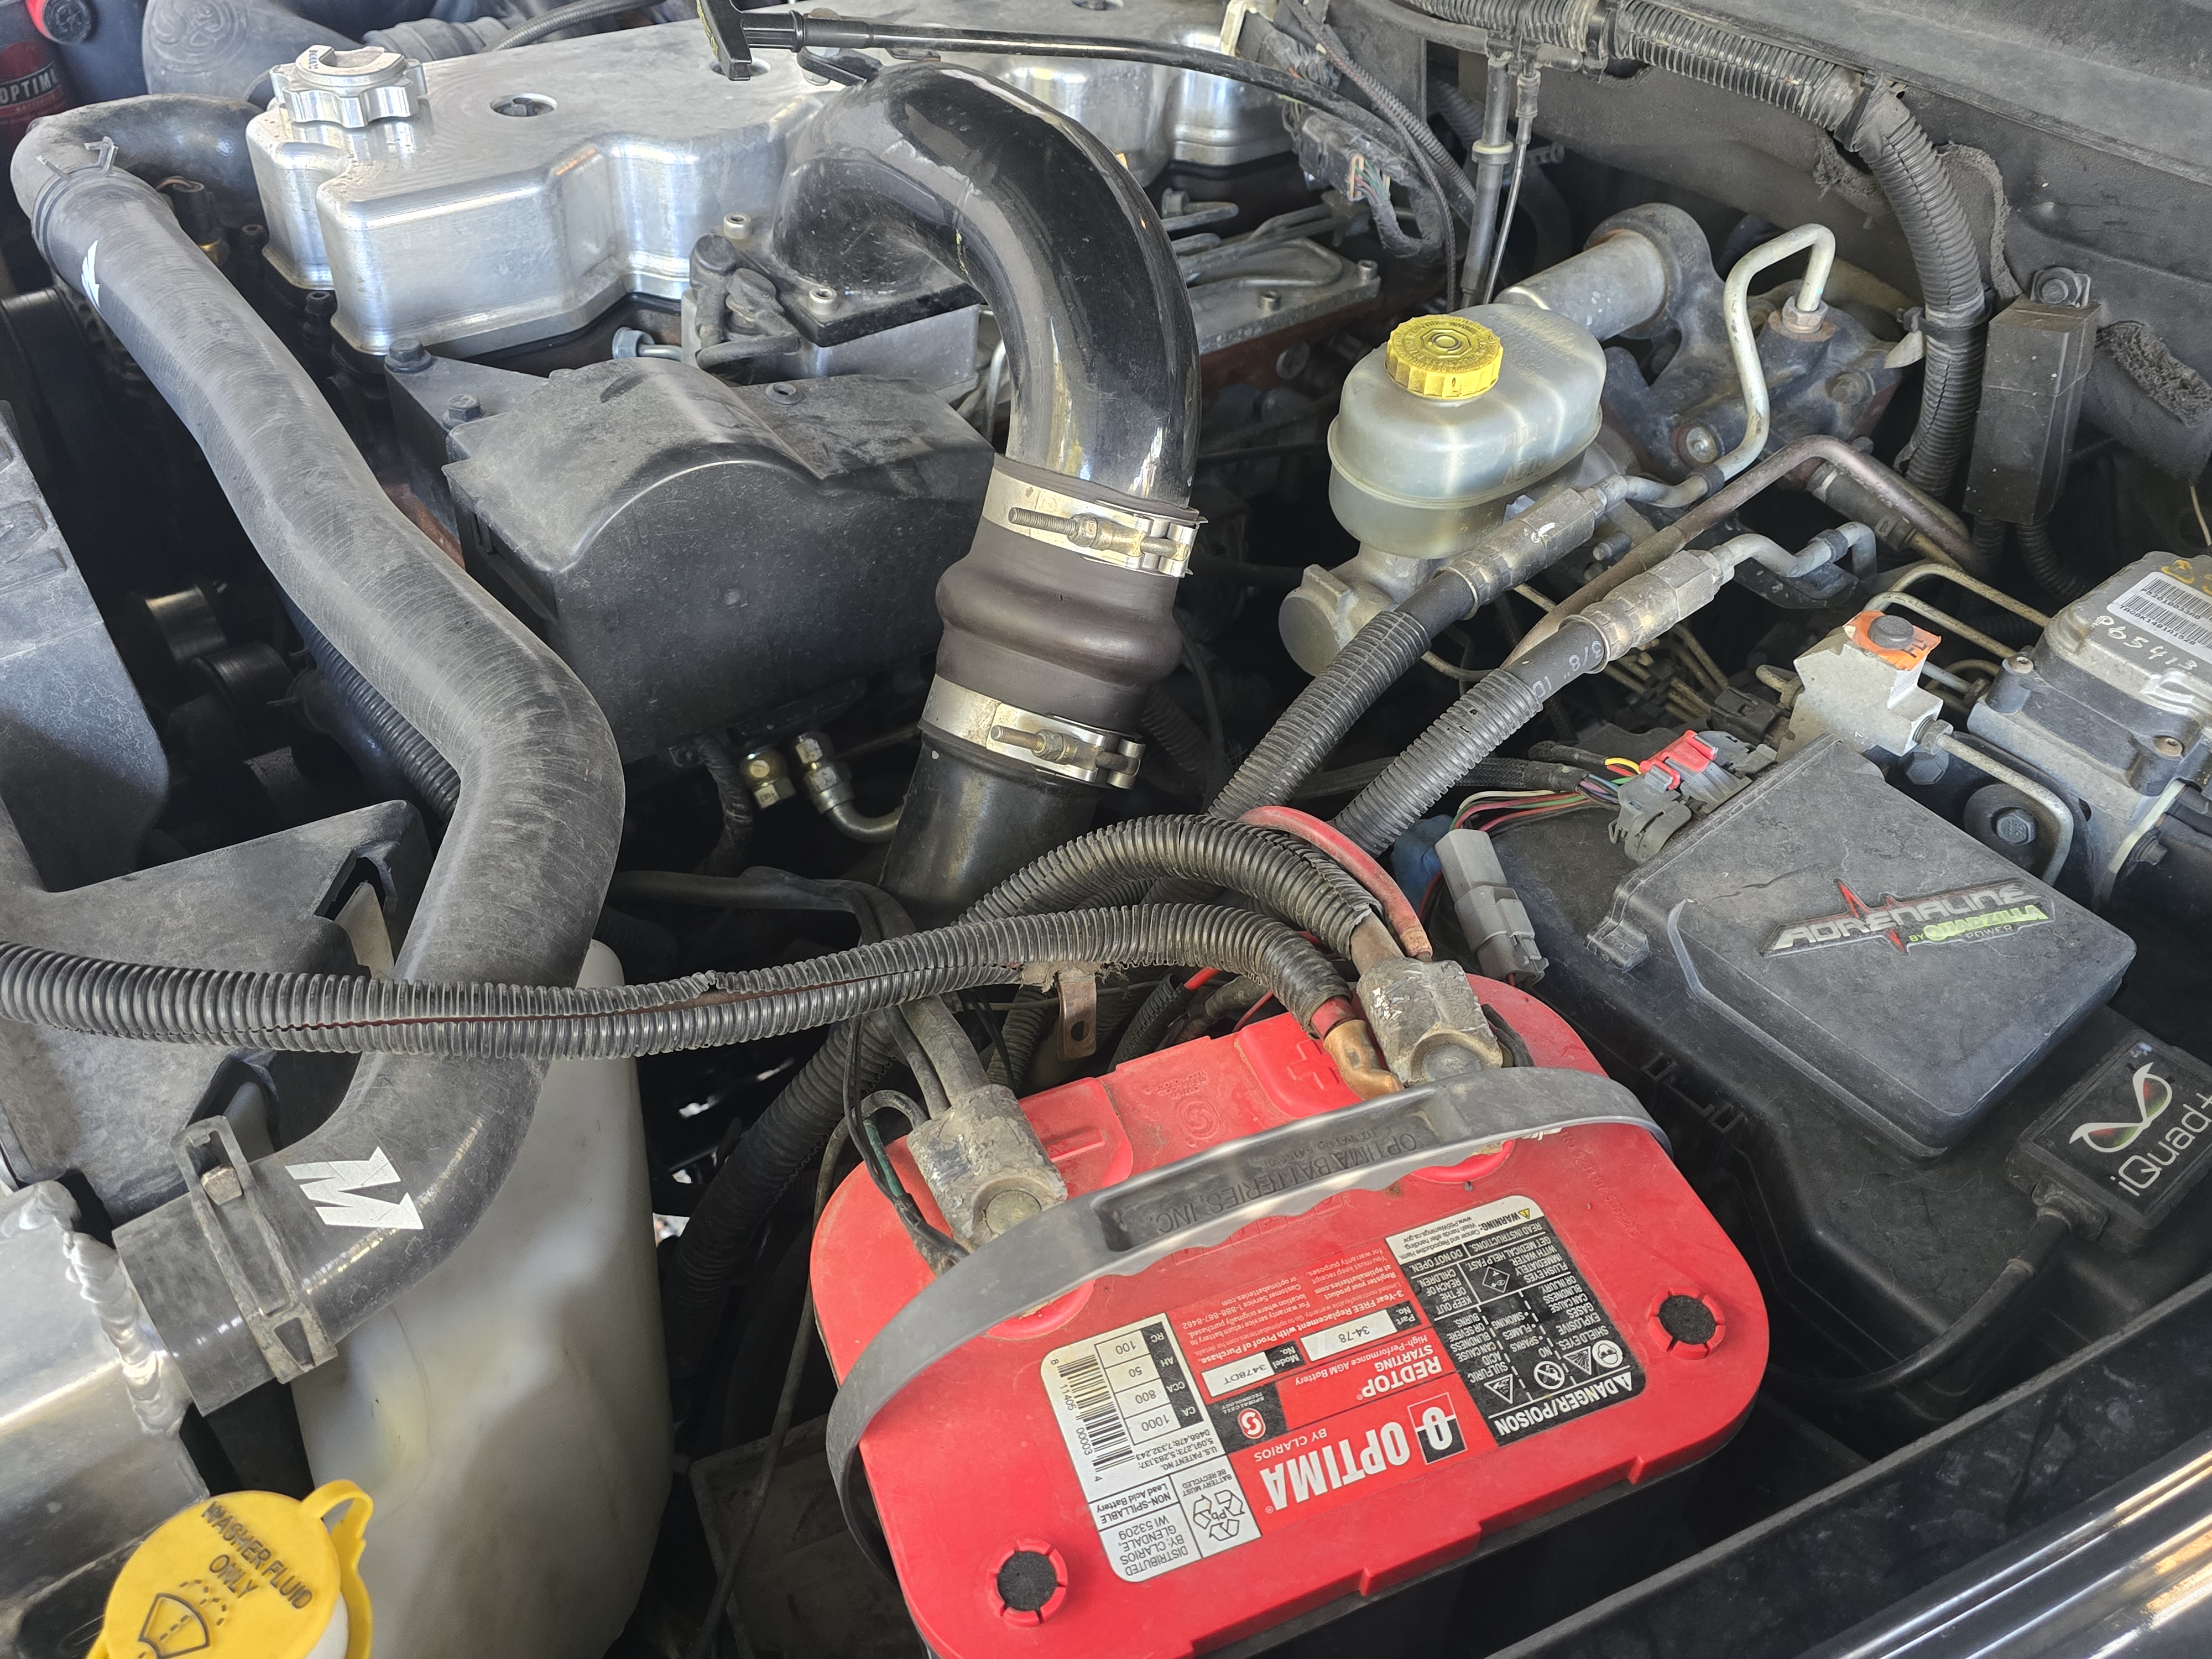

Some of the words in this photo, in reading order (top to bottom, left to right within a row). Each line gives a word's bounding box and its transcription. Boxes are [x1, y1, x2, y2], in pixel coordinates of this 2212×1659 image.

[2091, 615, 2198, 671] P65413
[1532, 676, 1552, 698] ID
[1773, 885, 2042, 950] ADRENALINE
[1909, 933, 1924, 943] BY
[1923, 904, 2048, 941] QUADZILLA
[1966, 925, 2013, 939] POWER
[1332, 1133, 1417, 1170] OPTIMA
[2110, 1091, 2212, 1196] iQuad+
[1150, 1202, 1196, 1233] INC.
[1477, 1212, 1520, 1232] WARNING:
[1441, 1227, 1460, 1238] hands
[1458, 1221, 1477, 1232] Wash
[1459, 1228, 1480, 1239] Cancer
[1520, 1222, 1542, 1235] READ
[1403, 1237, 1430, 1251] handling.
[1428, 1233, 1443, 1243] after
[1448, 1235, 1460, 1243] and
[1469, 1228, 1524, 1253] INSTRUCTIONS.
[1534, 1235, 1552, 1247] GET
[1369, 1246, 1383, 1257] for
[1415, 1239, 1450, 1255] Reproductive
[1449, 1249, 1463, 1259] DO
[1503, 1240, 1537, 1258] MEDICAL
[1535, 1244, 1557, 1257] WITH
[1339, 1250, 1372, 1267] warranty
[1371, 1254, 1387, 1264] You
[1397, 1250, 1416, 1261] Harm.
[1432, 1253, 1451, 1265] NOT
[1484, 1251, 1506, 1265] HELP
[1508, 1250, 1538, 1267] WATER.
[1305, 1260, 1341, 1279] purposes.
[1335, 1265, 1354, 1276] keep
[1353, 1259, 1373, 1271] must
[1382, 1263, 1392, 1272] at
[1408, 1258, 1434, 1274] OPEN.
[1464, 1258, 1488, 1271] FAST.
[1513, 1253, 1563, 1275] IMMEDIATELY
[1541, 1261, 1568, 1276] FLUSH
[1288, 1275, 1298, 1284] or
[1310, 1271, 1337, 1285] receipt
[1313, 1266, 1384, 1295] optimabatteries.com
[1365, 1270, 1396, 1286] Register
[1416, 1268, 1457, 1288] CHILDREN.
[1434, 1277, 1462, 1292] REACH
[1522, 1270, 1544, 1283] EYES
[1563, 1274, 1577, 1285] OR
[1220, 1277, 1290, 1307] optimabatteries.com
[1267, 1283, 1302, 1300] Customer
[1323, 1285, 1352, 1301] product
[1350, 1280, 1368, 1292] your
[1424, 1286, 1436, 1296] OF
[1454, 1286, 1467, 1296] OF
[1537, 1278, 1567, 1294] INJURY.
[1542, 1284, 1583, 1304] BLINDNESS
[1242, 1294, 1269, 1308] Service
[1277, 1292, 1307, 1308] location
[1374, 1288, 1405, 1305] 3-Year
[1439, 1289, 1457, 1302] THE
[1450, 1295, 1472, 1308] KEEP
[1569, 1292, 1588, 1305] CAN
[1255, 1301, 1279, 1315] where
[1267, 1303, 1298, 1320] warranty
[1296, 1299, 1311, 1310] For
[1351, 1298, 1376, 1313] FREE
[1395, 1305, 1411, 1317] No.
[1434, 1301, 1453, 1314] OUT
[1547, 1297, 1573, 1313] CAUSE
[1565, 1301, 1595, 1319] GASES
[1181, 1303, 1243, 1329] 1-888-867-8462
[1224, 1309, 1258, 1326] originally
[1242, 1313, 1270, 1329] service
[1296, 1306, 1353, 1332] Replacement
[1395, 1313, 1416, 1326] Part
[1452, 1312, 1480, 1328] BURNS.
[1490, 1311, 1525, 1329] SMOKING
[1554, 1311, 1601, 1335] EXPLOSIVE
[1186, 1319, 1226, 1339] purchased.
[1222, 1322, 1245, 1336] return
[1275, 1325, 1297, 1339] with
[1337, 1324, 1371, 1343] 34-78
[1446, 1326, 1475, 1342] SEVERE
[1472, 1322, 1486, 1333] OR
[1501, 1323, 1532, 1340] FLAMES
[1577, 1324, 1609, 1343] SHIELD
[1149, 1332, 1165, 1343] RC
[1189, 1337, 1199, 1347] to
[1197, 1329, 1224, 1344] battery
[1251, 1332, 1277, 1348] Proof
[1449, 1331, 1491, 1353] BLINDNESS
[1509, 1335, 1539, 1352] SPARKS
[1555, 1334, 1582, 1351] EYES.
[1114, 1340, 1137, 1355] 100
[1240, 1340, 1253, 1352] of
[1279, 1345, 1296, 1357] No.
[1349, 1332, 1429, 1368] High-Performance
[1455, 1346, 1481, 1362] CAUSE
[1479, 1340, 1497, 1353] CAN
[1536, 1345, 1553, 1358] NO
[1160, 1355, 1175, 1367] AH
[1197, 1344, 1243, 1366] Purchase.
[1271, 1353, 1300, 1369] Model
[1373, 1343, 1435, 1373] STARTING
[1480, 1350, 1503, 1365] ACID
[1127, 1365, 1143, 1378] 50
[1222, 1364, 1267, 1385] 3478DT
[1326, 1359, 1352, 1375] AGM
[1466, 1360, 1509, 1383] SULFURIC
[1293, 1367, 1329, 1387] Battery
[1166, 1380, 1186, 1393] CCA
[1059, 1383, 1076, 1411] 11405
[1134, 1389, 1157, 1405] 800
[1220, 1392, 1262, 1410] TECHNOLOGY
[1222, 1396, 1265, 1413] SPIRALCELL
[1181, 1405, 1197, 1417] CA
[1493, 1378, 1619, 1436] DANGER/POISON
[1140, 1413, 1171, 1432] 1000
[1075, 1427, 1093, 1455] 00003
[1308, 1427, 1329, 1442] BY
[1175, 1436, 1214, 1455] 5,091,273;
[1202, 1445, 1218, 1456] U.S.
[1252, 1434, 1309, 1462] CLARIOS
[1137, 1450, 1176, 1469] 5,283,137;
[1160, 1460, 1174, 1471] NO.
[1173, 1451, 1202, 1466] PATENT
[1181, 1472, 1215, 1489] RECYCLED
[1215, 1468, 1227, 1477] BE
[1146, 1481, 1167, 1495] Lead
[1201, 1473, 1232, 1489] BATTERY
[1127, 1489, 1147, 1502] Acid
[1181, 1484, 1202, 1496] MUST
[1095, 1495, 1128, 1514] Battery
[1099, 1491, 1172, 1524] NON-SPILLABLE
[1154, 1514, 1170, 1527] WI
[1210, 1508, 1227, 1522] Pb
[1117, 1520, 1154, 1541] 53209
[1118, 1522, 1177, 1553] GLENDALE,
[1166, 1533, 1185, 1548] BY:
[201, 1501, 272, 1570] WASHER
[262, 1559, 313, 1610] FLUID
[1119, 1540, 1167, 1566] CLARIOS
[1123, 1545, 1188, 1577] DISTRIBUTED
[209, 1554, 259, 1599] ONLY
